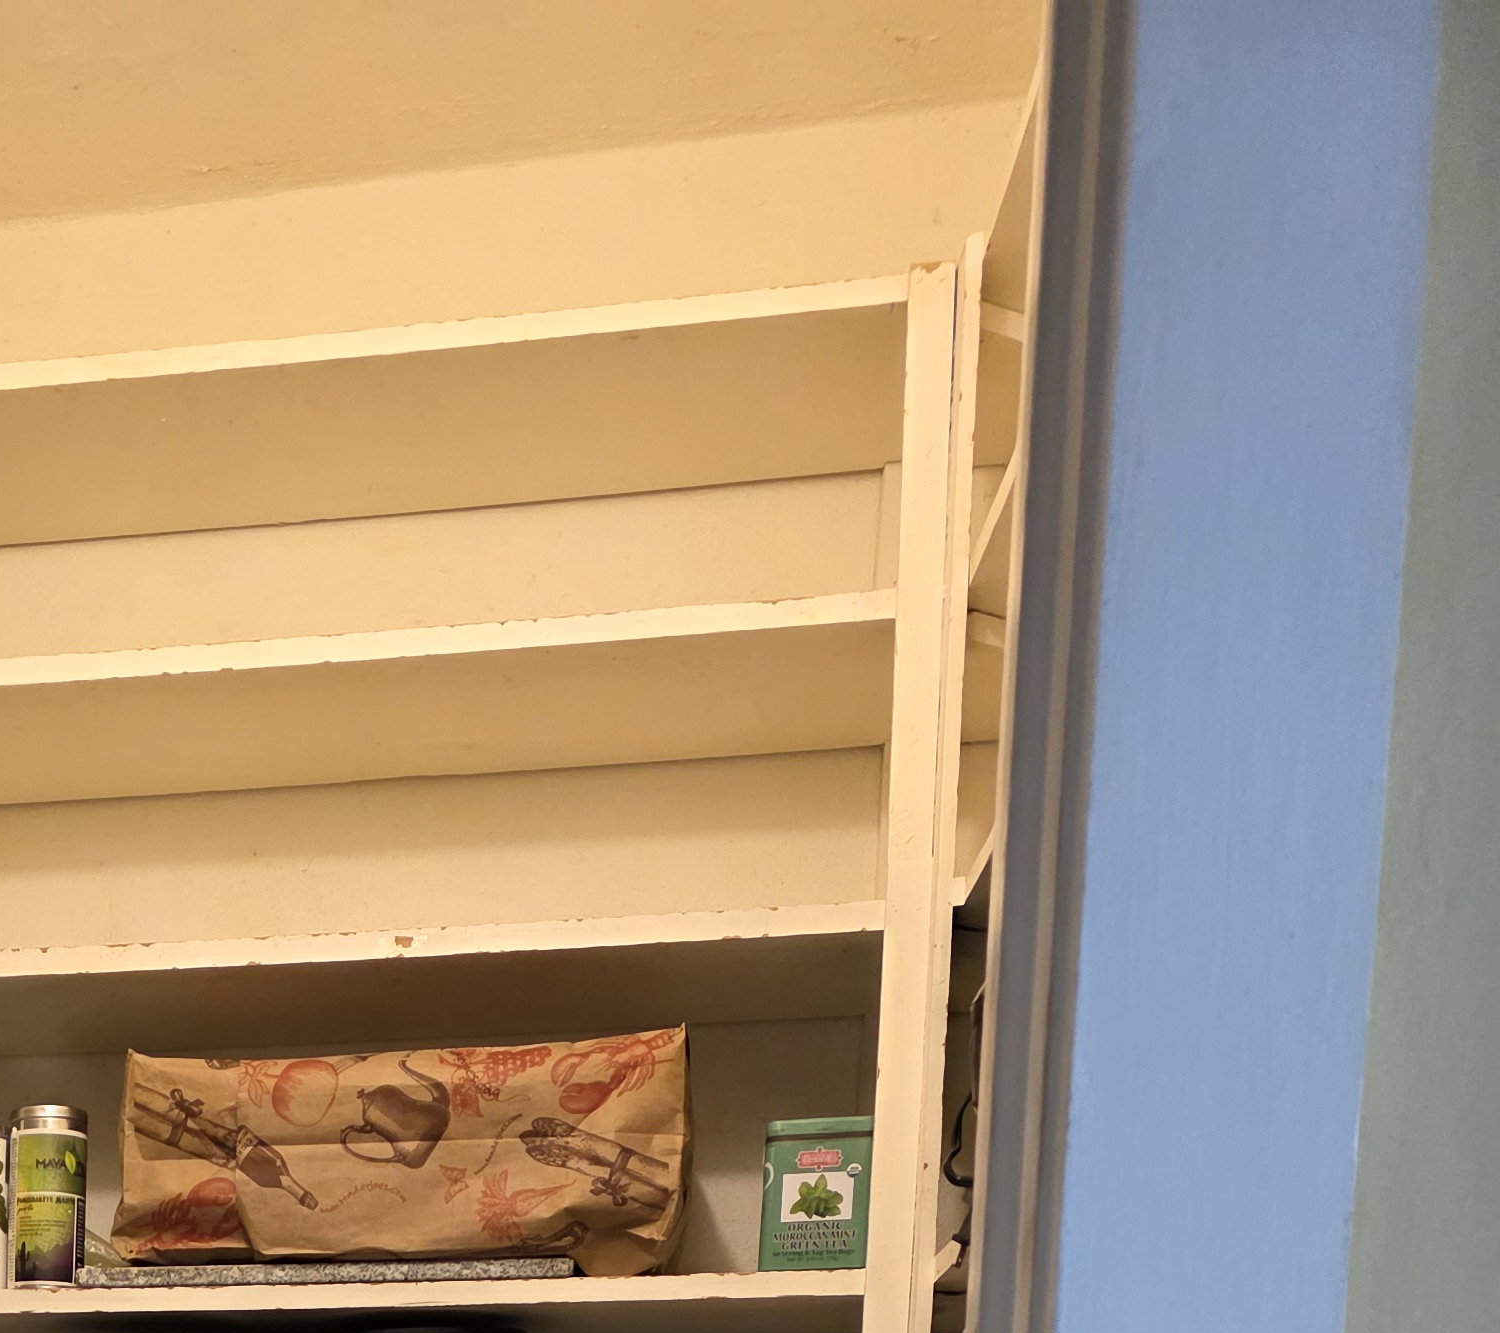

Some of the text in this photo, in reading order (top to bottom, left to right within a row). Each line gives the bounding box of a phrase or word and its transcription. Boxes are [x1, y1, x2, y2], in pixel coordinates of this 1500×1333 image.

[35, 1158, 66, 1169] MAYA
[788, 1221, 842, 1231] ORGANIC
[773, 1229, 857, 1241] MOROCCAN MINT
[781, 1239, 848, 1250] GREEN TEA
